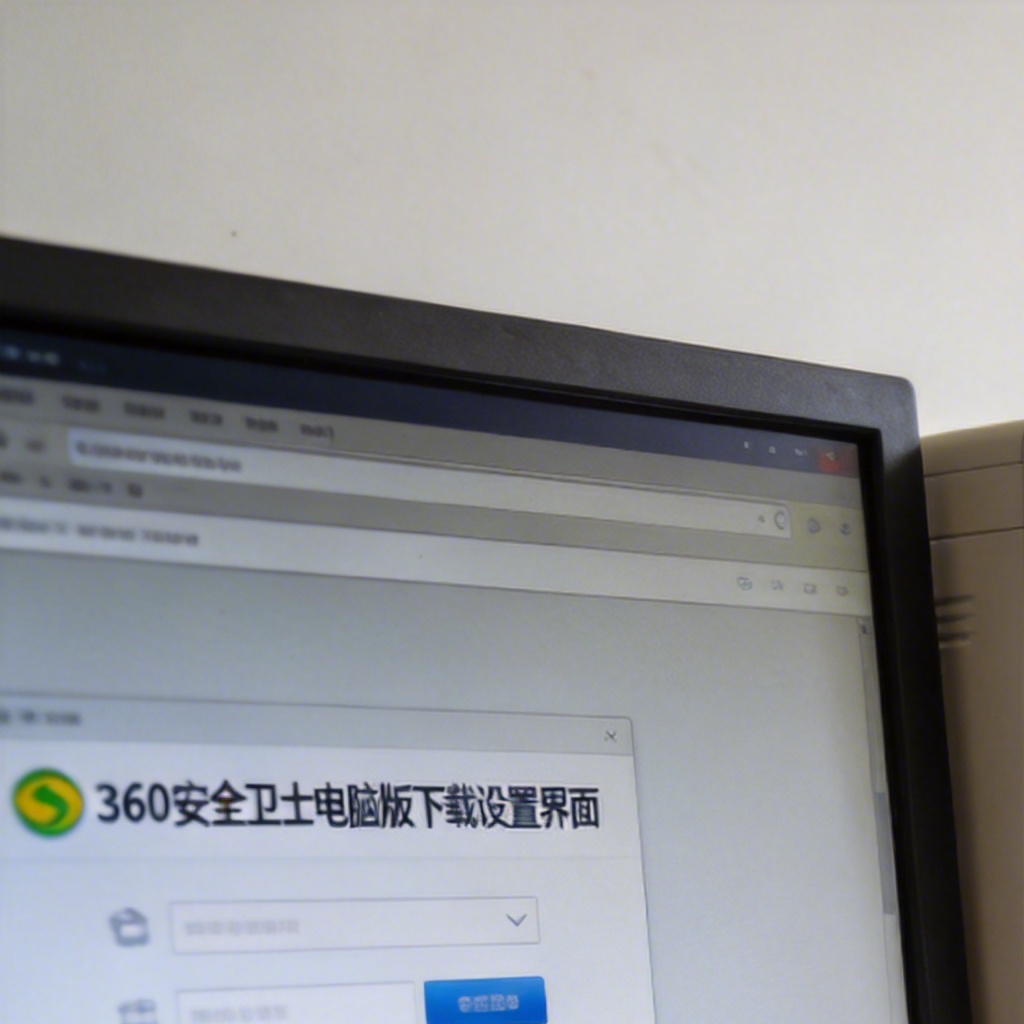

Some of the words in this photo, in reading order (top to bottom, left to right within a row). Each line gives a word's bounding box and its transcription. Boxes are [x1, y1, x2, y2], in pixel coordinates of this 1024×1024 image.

[96, 779, 600, 829] 360安全卫士电脑版下载设置界面
